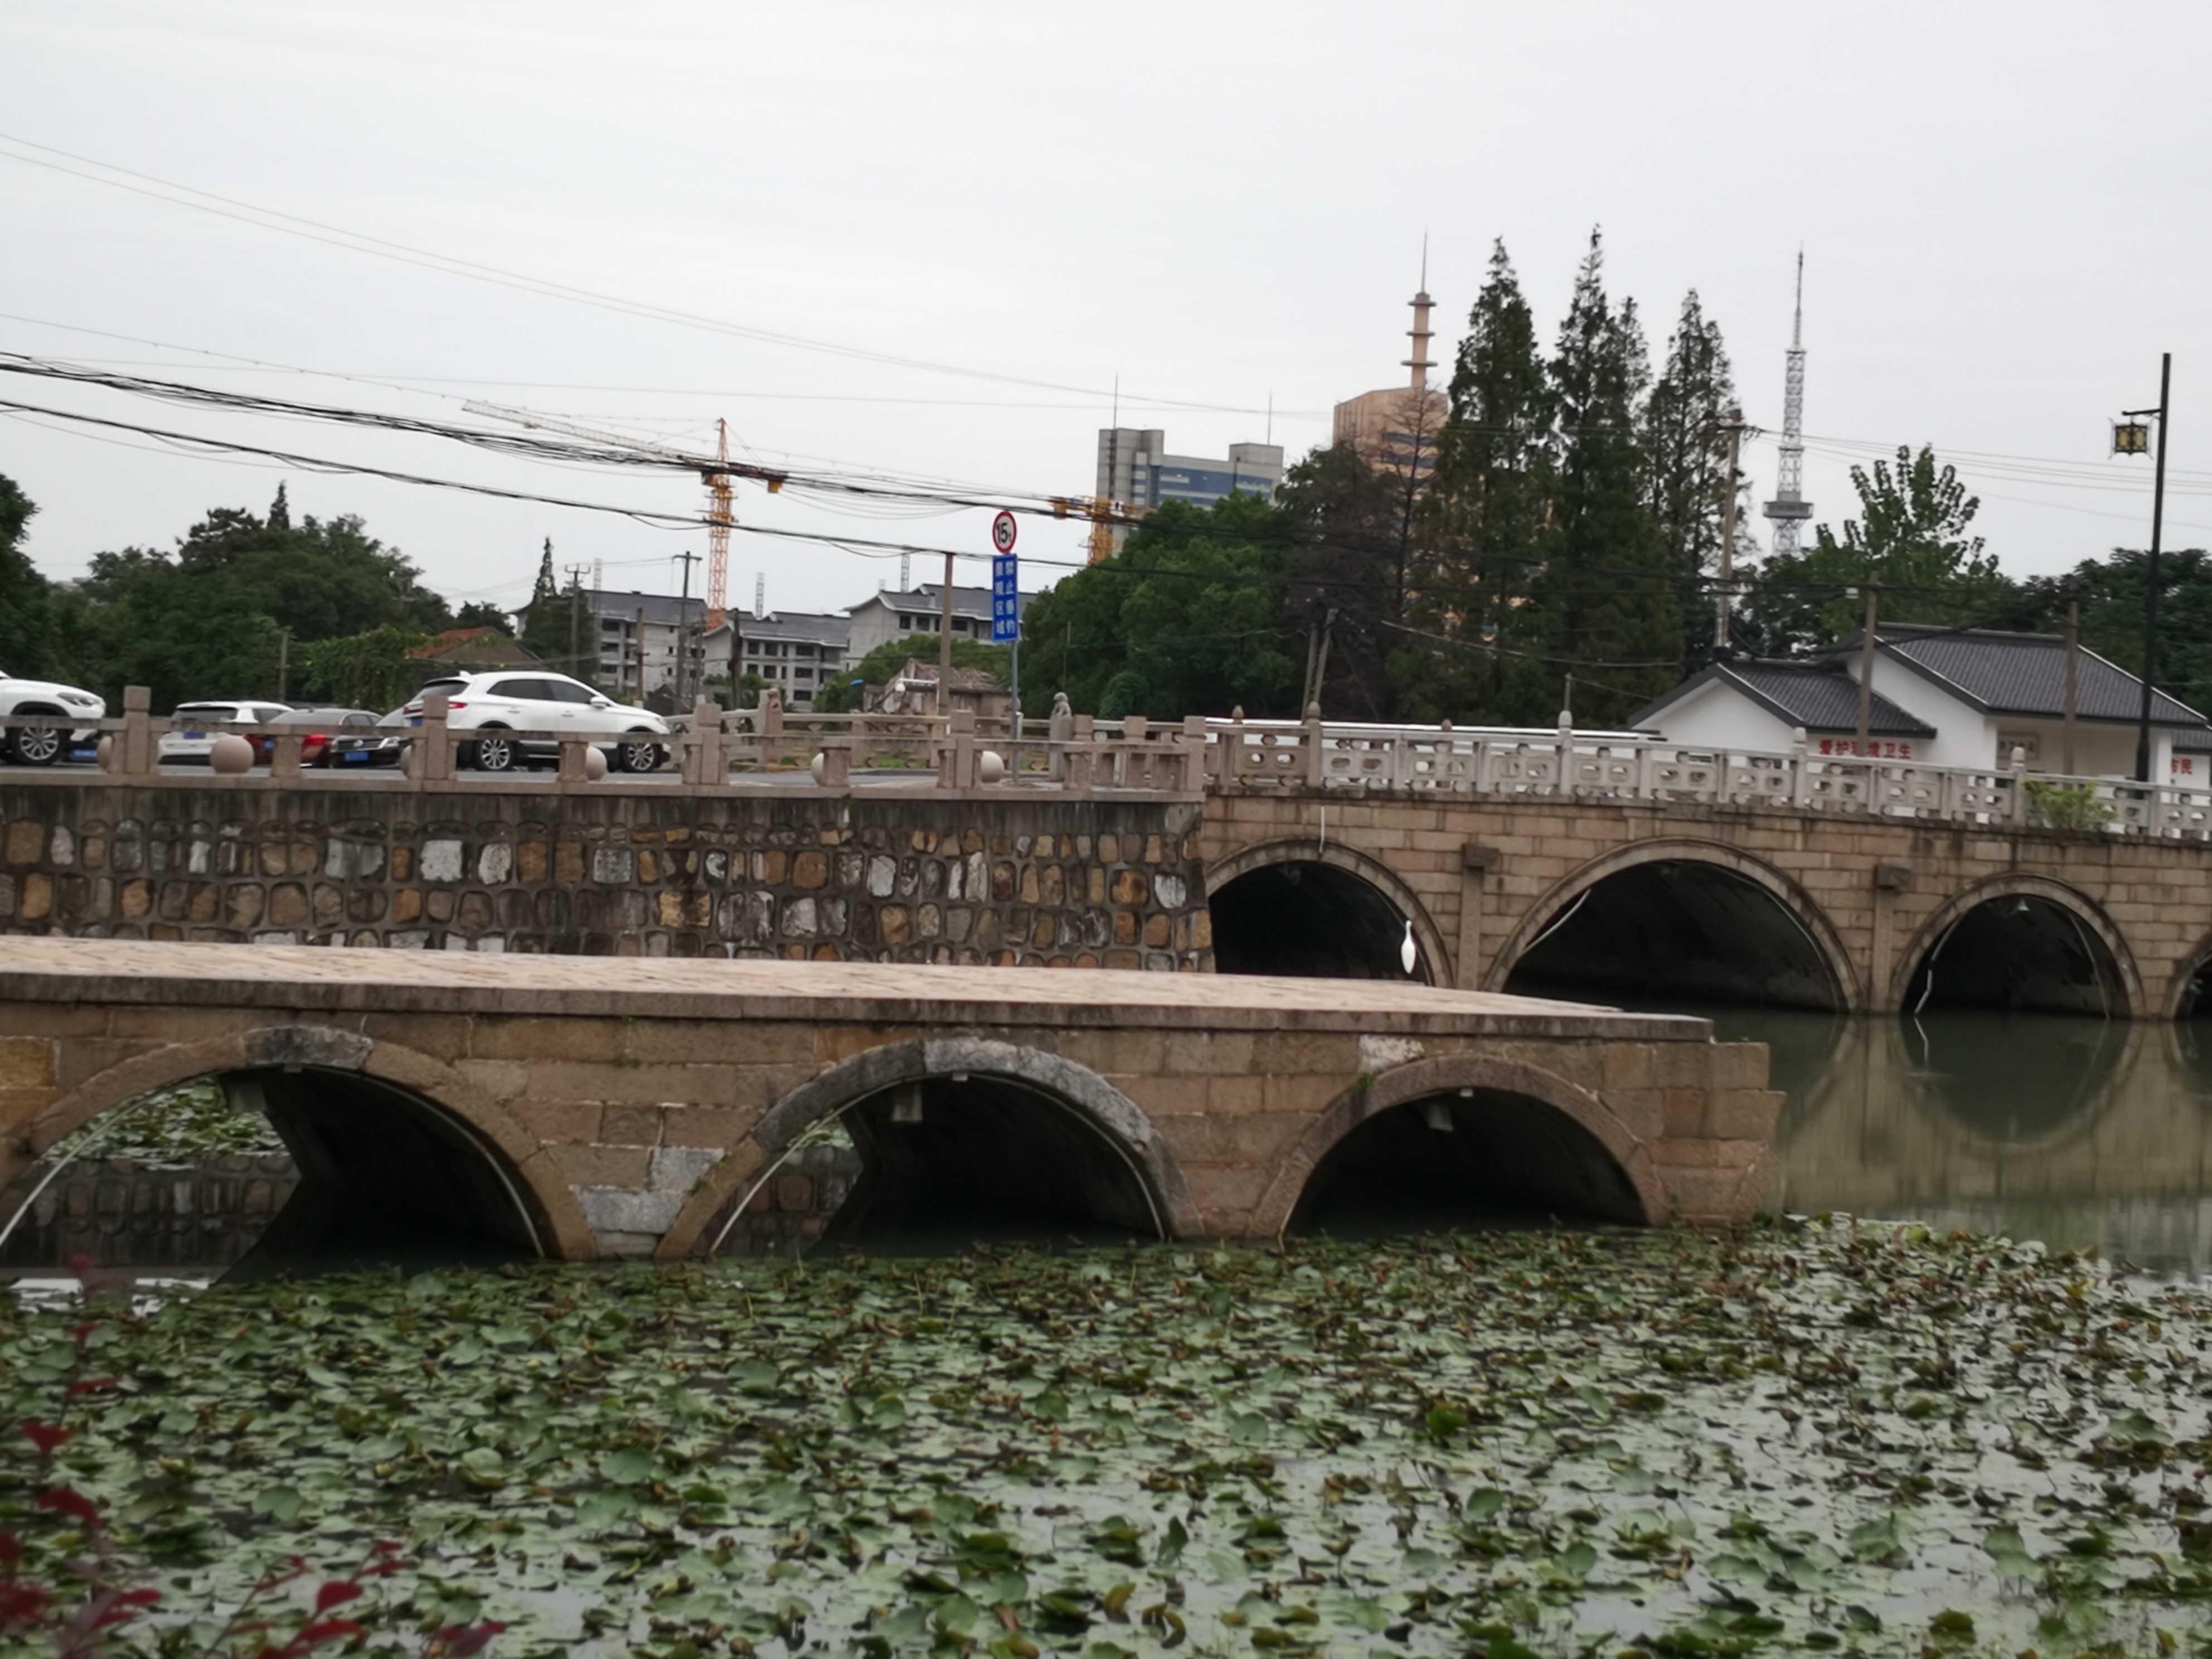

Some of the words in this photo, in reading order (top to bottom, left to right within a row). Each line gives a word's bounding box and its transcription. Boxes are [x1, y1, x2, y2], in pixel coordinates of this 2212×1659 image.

[995, 561, 1005, 634] 景观区域
[1005, 560, 1015, 634] 禁止垂钓
